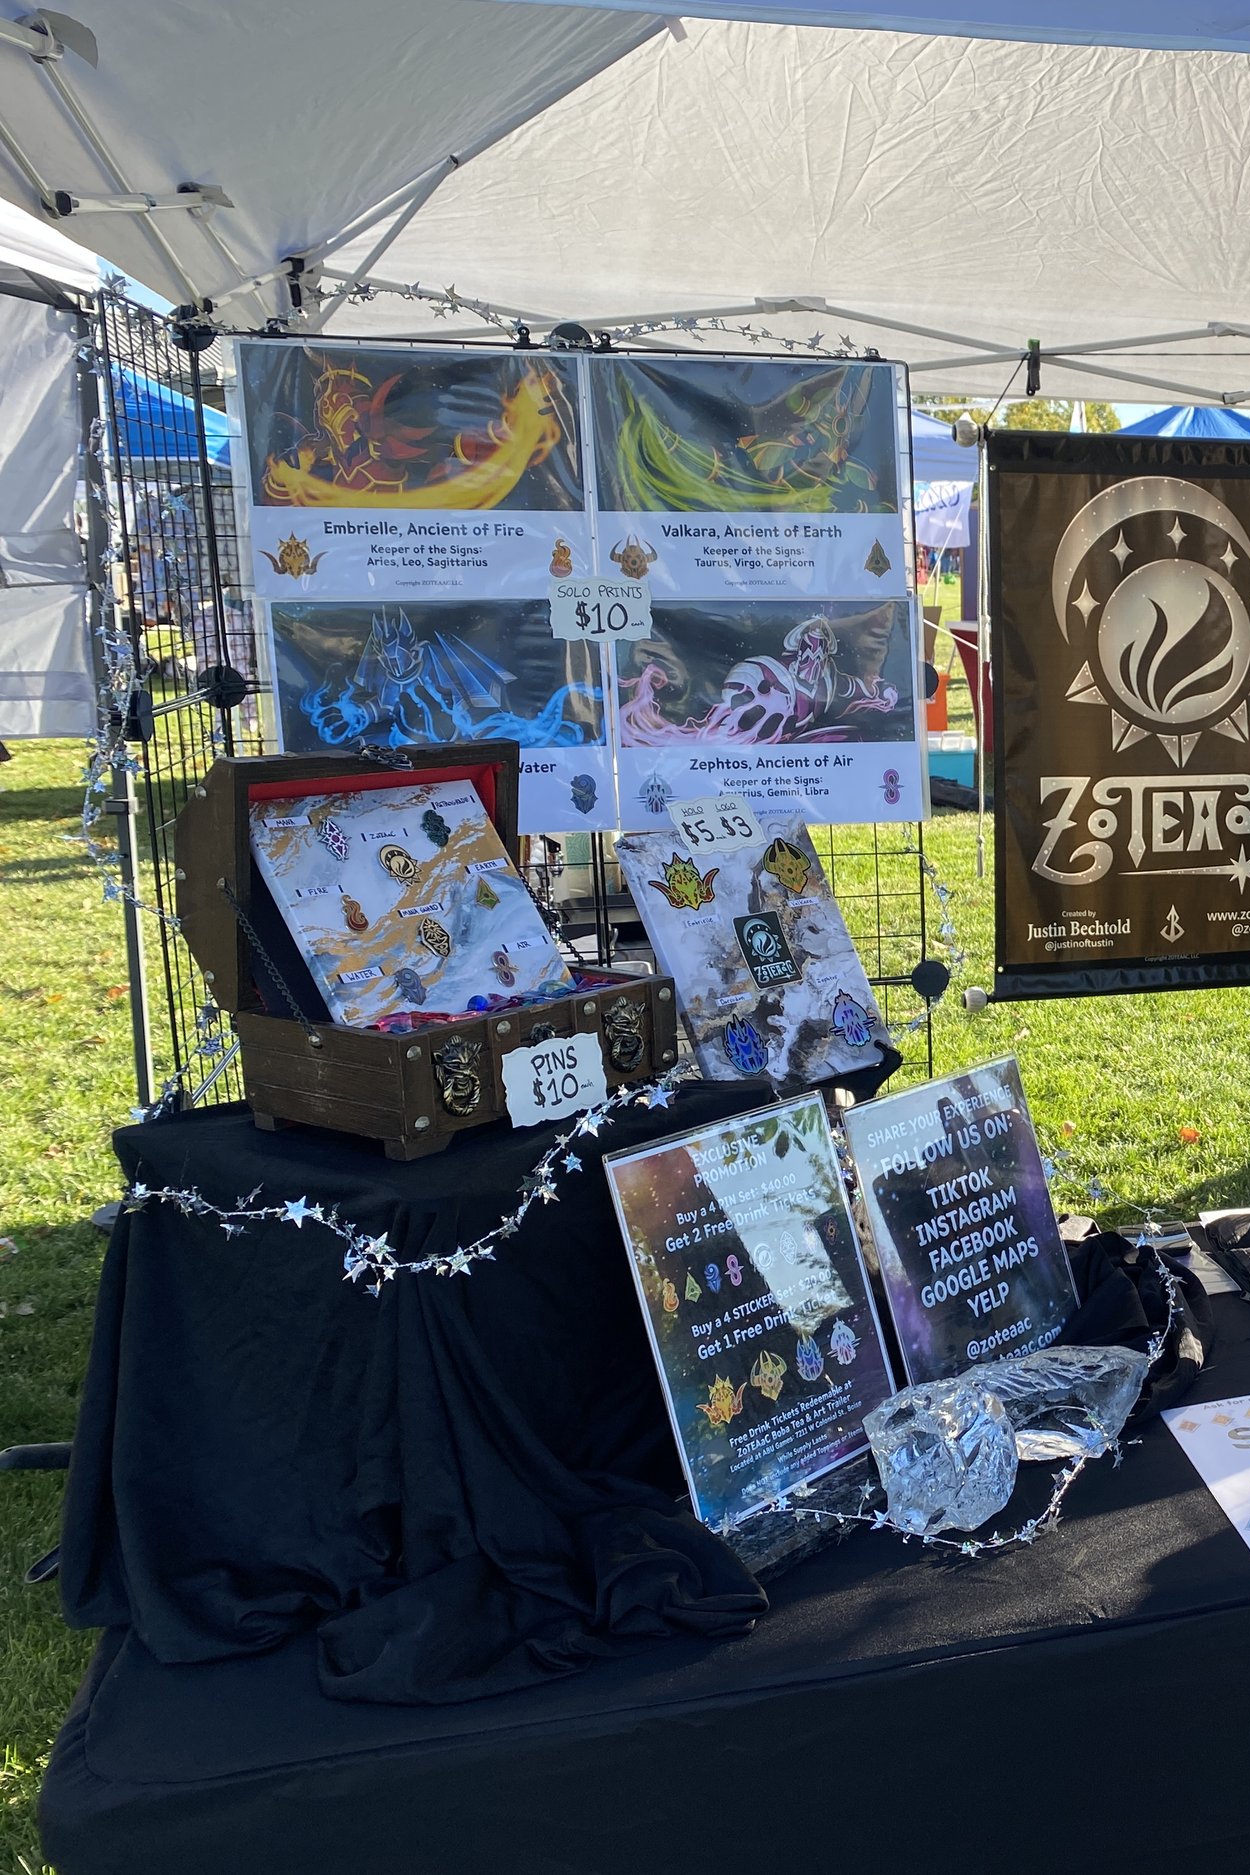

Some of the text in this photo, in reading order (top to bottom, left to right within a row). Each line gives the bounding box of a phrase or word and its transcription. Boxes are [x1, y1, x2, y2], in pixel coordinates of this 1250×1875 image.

[323, 521, 524, 540] Embrielle, Ancient of Fire
[661, 524, 842, 540] Valkara, Ancient of Earth
[367, 557, 488, 569] Aries, Leo, Sagittarius
[371, 544, 483, 558] Keeper of the Signs:
[694, 558, 815, 571] Taurus, Virgo, Capricorn
[703, 546, 805, 558] Keeper of the Signs:
[557, 584, 643, 599] SOLO PRINTS
[575, 601, 628, 634] $10
[689, 754, 854, 773] Zephtos, Ancient of Air
[723, 776, 823, 788] Keeper of the Signs:
[681, 806, 704, 817] HOLO
[681, 816, 753, 846] $5 $3
[475, 861, 498, 873] EARTH
[308, 887, 329, 895] FIRE
[1027, 918, 1131, 941] Justin Bechtold
[1061, 909, 1096, 919] Created by
[516, 941, 530, 950] AIR
[1044, 938, 1114, 952] @justinoftustin
[347, 969, 378, 981] WATER
[530, 1045, 578, 1076] PINS
[533, 1073, 579, 1108] $10
[867, 1084, 1011, 1148] SHARE YOUR EXPERIENCE
[692, 1134, 759, 1168] EXCLUSIVE
[880, 1112, 1013, 1180] FOLLOW US ON:
[693, 1152, 767, 1188] PROMOTION
[676, 1173, 796, 1225] Buy a 4 PIN Set: $40.00
[926, 1166, 994, 1209] TIKTOK
[665, 1187, 816, 1252] Get 2 Free Drink Tickets
[915, 1185, 1017, 1247] INSTAGRAM
[928, 1216, 1018, 1273] FACEBOOK
[920, 1236, 1039, 1309] GOOGLE MAPS
[691, 1269, 832, 1338] Buy a 4 STICKER Set: $20.00
[966, 1281, 1010, 1318] YELP
[697, 1290, 838, 1360] Get 1 Free Drink Ticket
[966, 1316, 1033, 1360] @zoteaac
[729, 1380, 853, 1448] Free Drink Tickets Redeemable at
[771, 1425, 791, 1440] Boba
[790, 1418, 805, 1431] Tea
[805, 1413, 812, 1423] &
[813, 1407, 826, 1418] Art
[826, 1394, 851, 1412] Trailer
